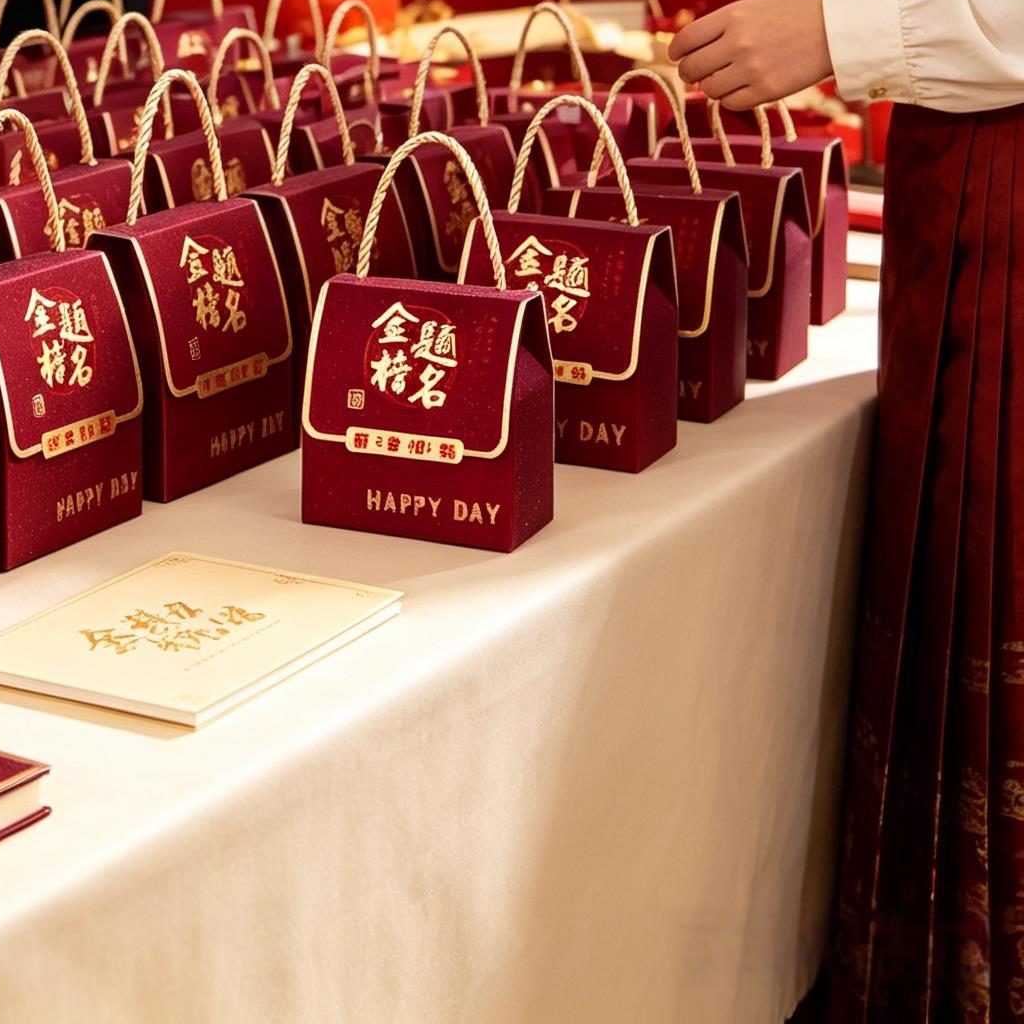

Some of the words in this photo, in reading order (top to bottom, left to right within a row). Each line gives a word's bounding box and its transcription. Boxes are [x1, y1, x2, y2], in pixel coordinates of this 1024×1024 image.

[579, 420, 627, 446] DAY
[366, 488, 442, 517] HAPPY
[453, 499, 501, 525] DAY
